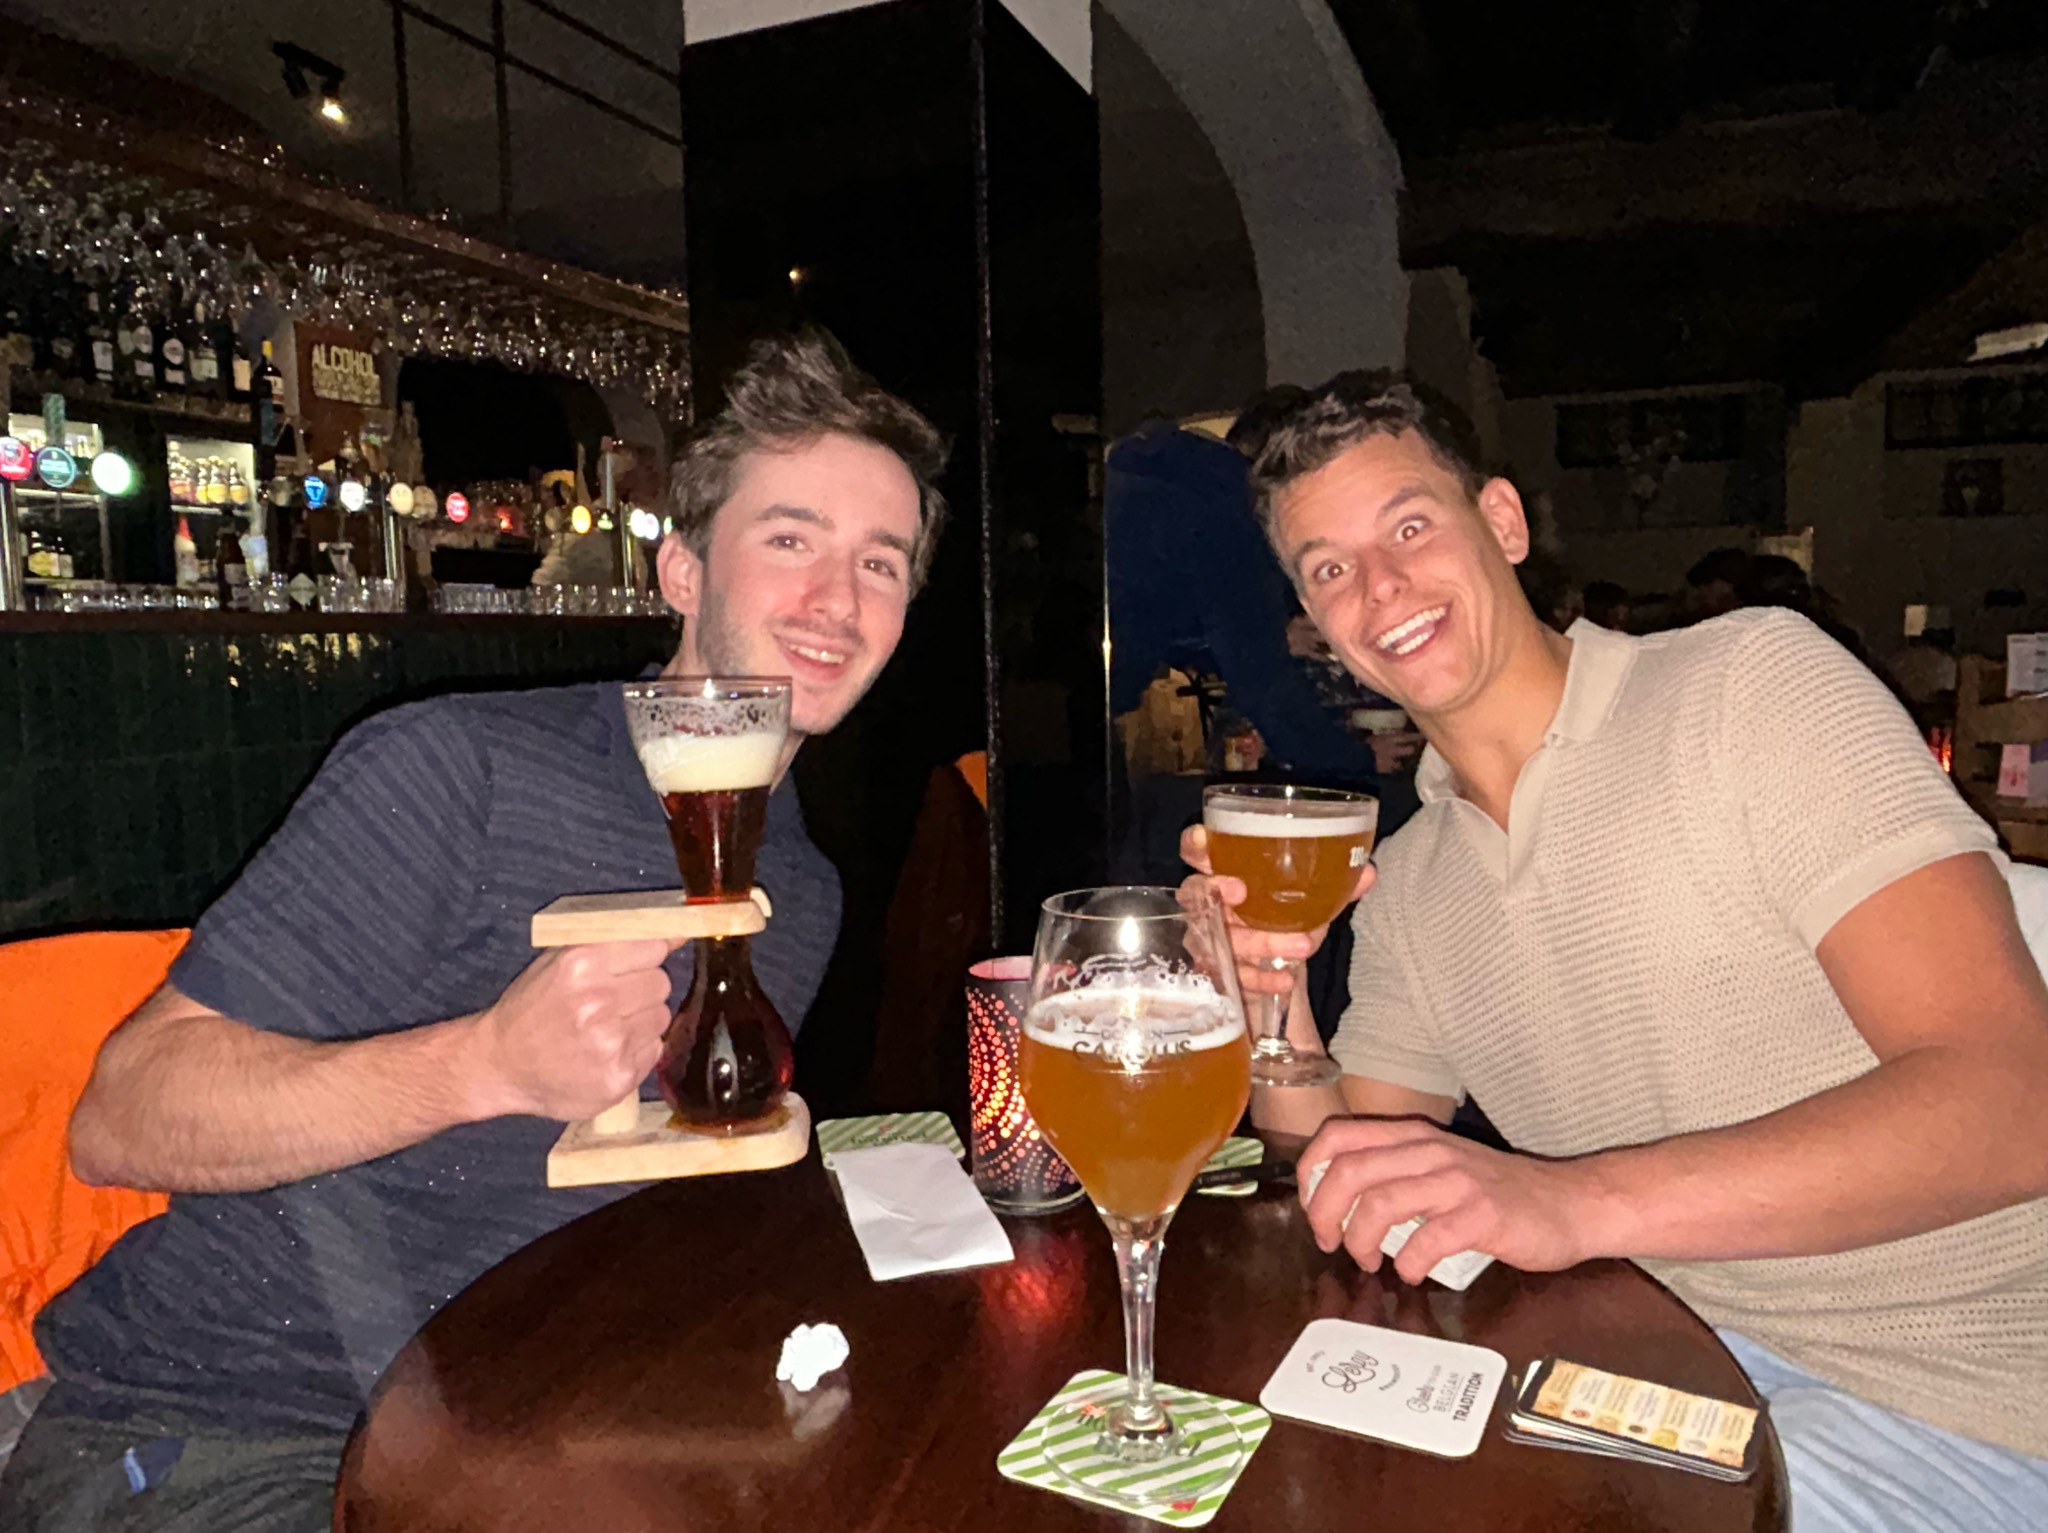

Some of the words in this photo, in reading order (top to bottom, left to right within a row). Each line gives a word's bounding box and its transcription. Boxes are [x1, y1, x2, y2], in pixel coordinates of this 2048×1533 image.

[312, 343, 380, 379] ALCOHOL
[1101, 1028, 1164, 1041] GON
[1433, 1371, 1459, 1413] BELGIAN
[1452, 1371, 1484, 1422] TRADITION
